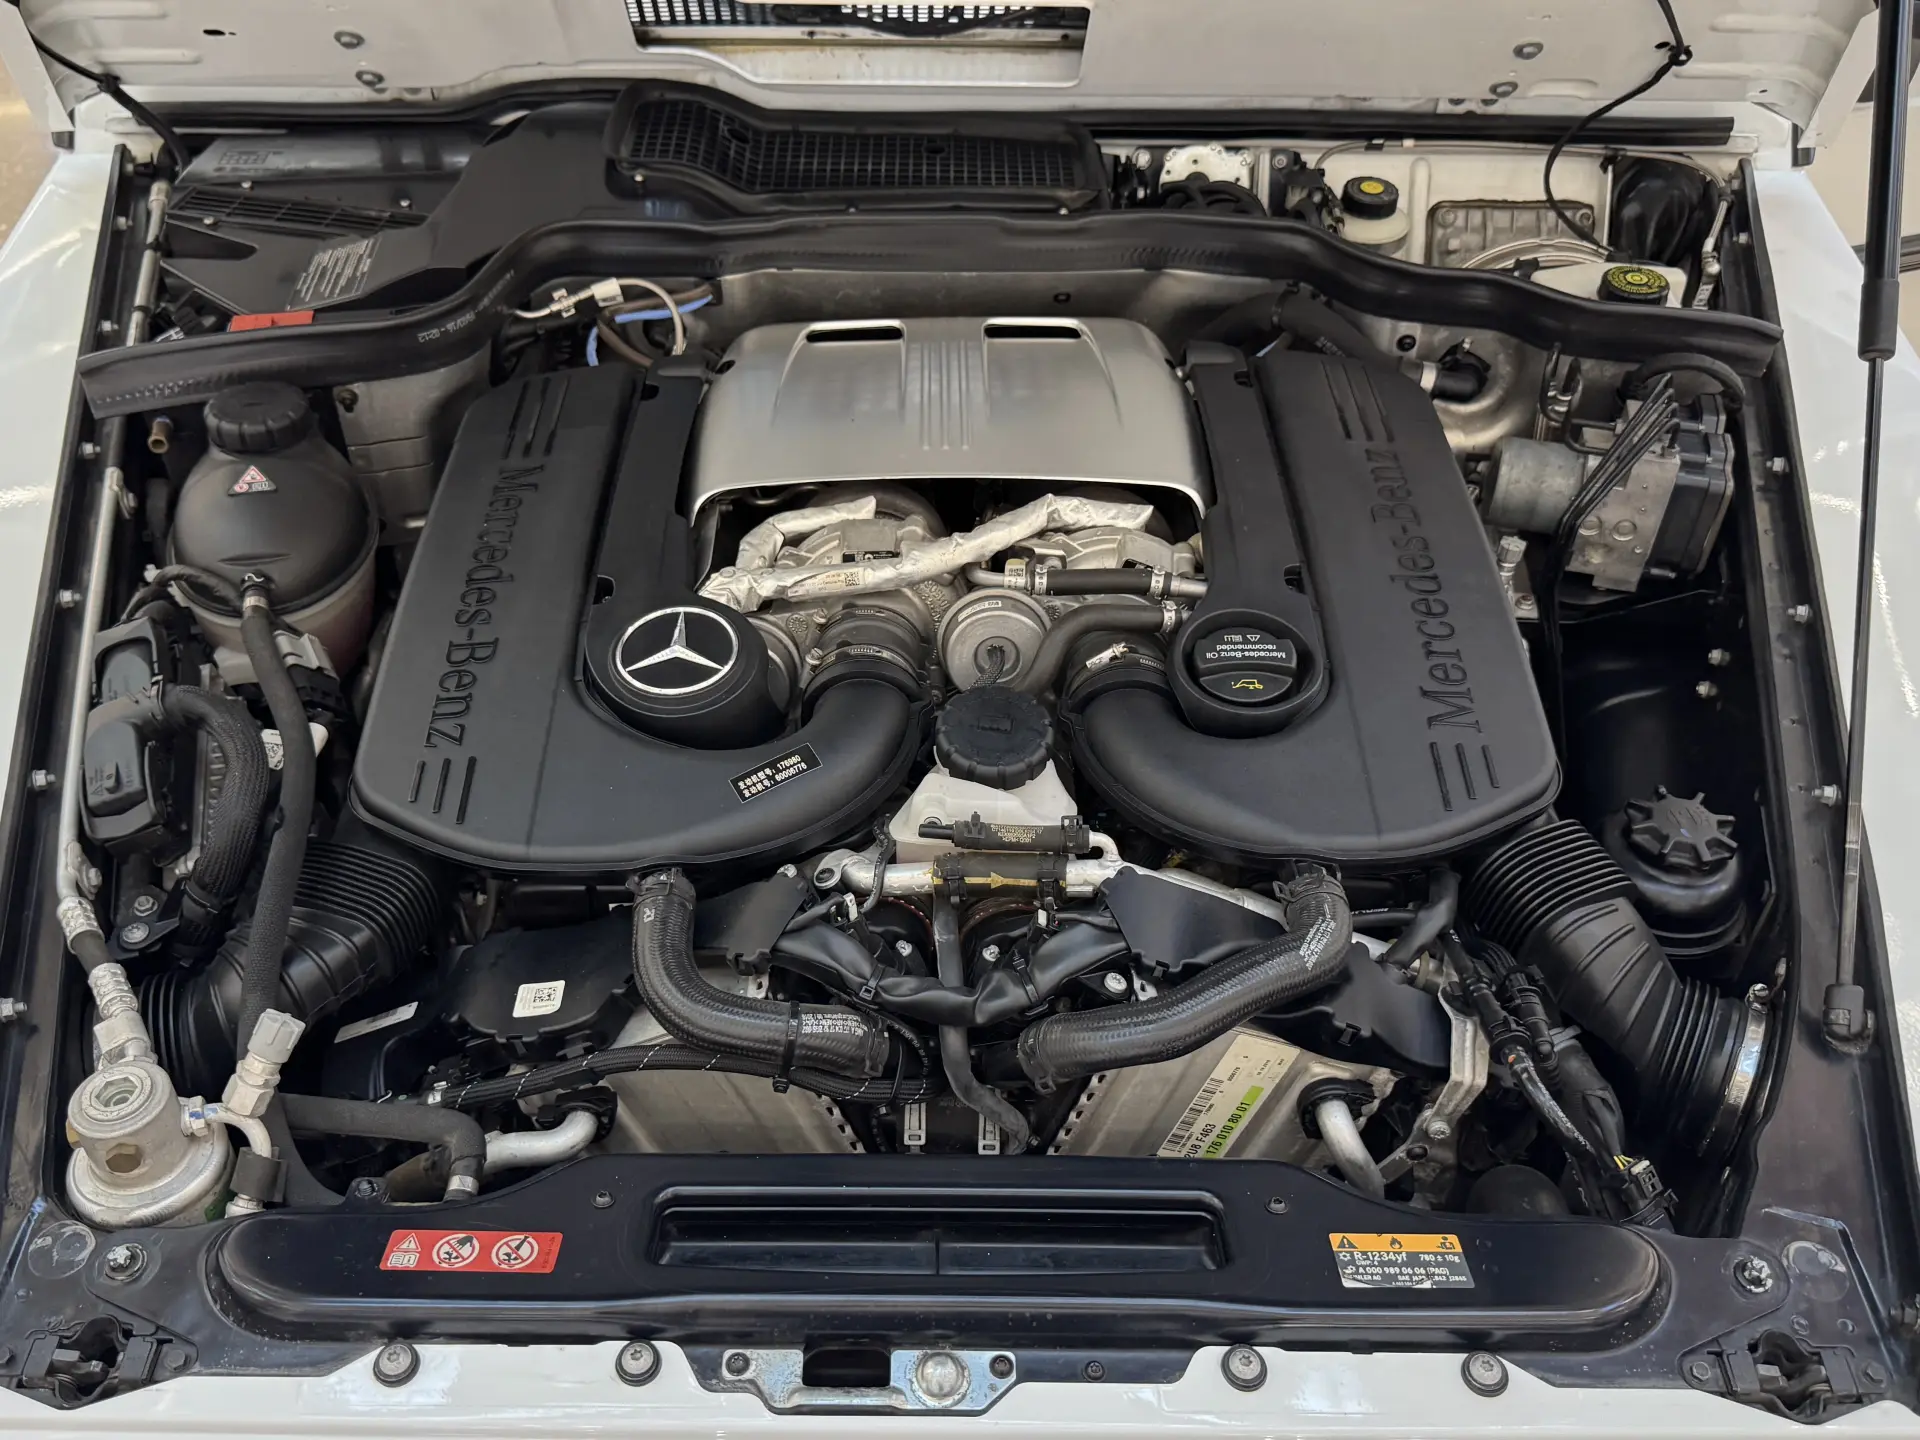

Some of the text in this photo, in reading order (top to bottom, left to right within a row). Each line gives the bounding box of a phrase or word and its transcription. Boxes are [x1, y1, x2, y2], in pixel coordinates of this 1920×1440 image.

[1366, 448, 1482, 733] Mercedes-Benz
[424, 464, 544, 748] Mercedes-Benz
[1220, 651, 1286, 659] Mercedes-Benz
[1196, 1123, 1216, 1143] F463
[1206, 1102, 1251, 1155] 176 010 80 01
[1354, 1252, 1407, 1263] R-1234yf
[1384, 1267, 1400, 1275] 989
[1403, 1267, 1413, 1275] 06
[1415, 1267, 1426, 1275] 06
